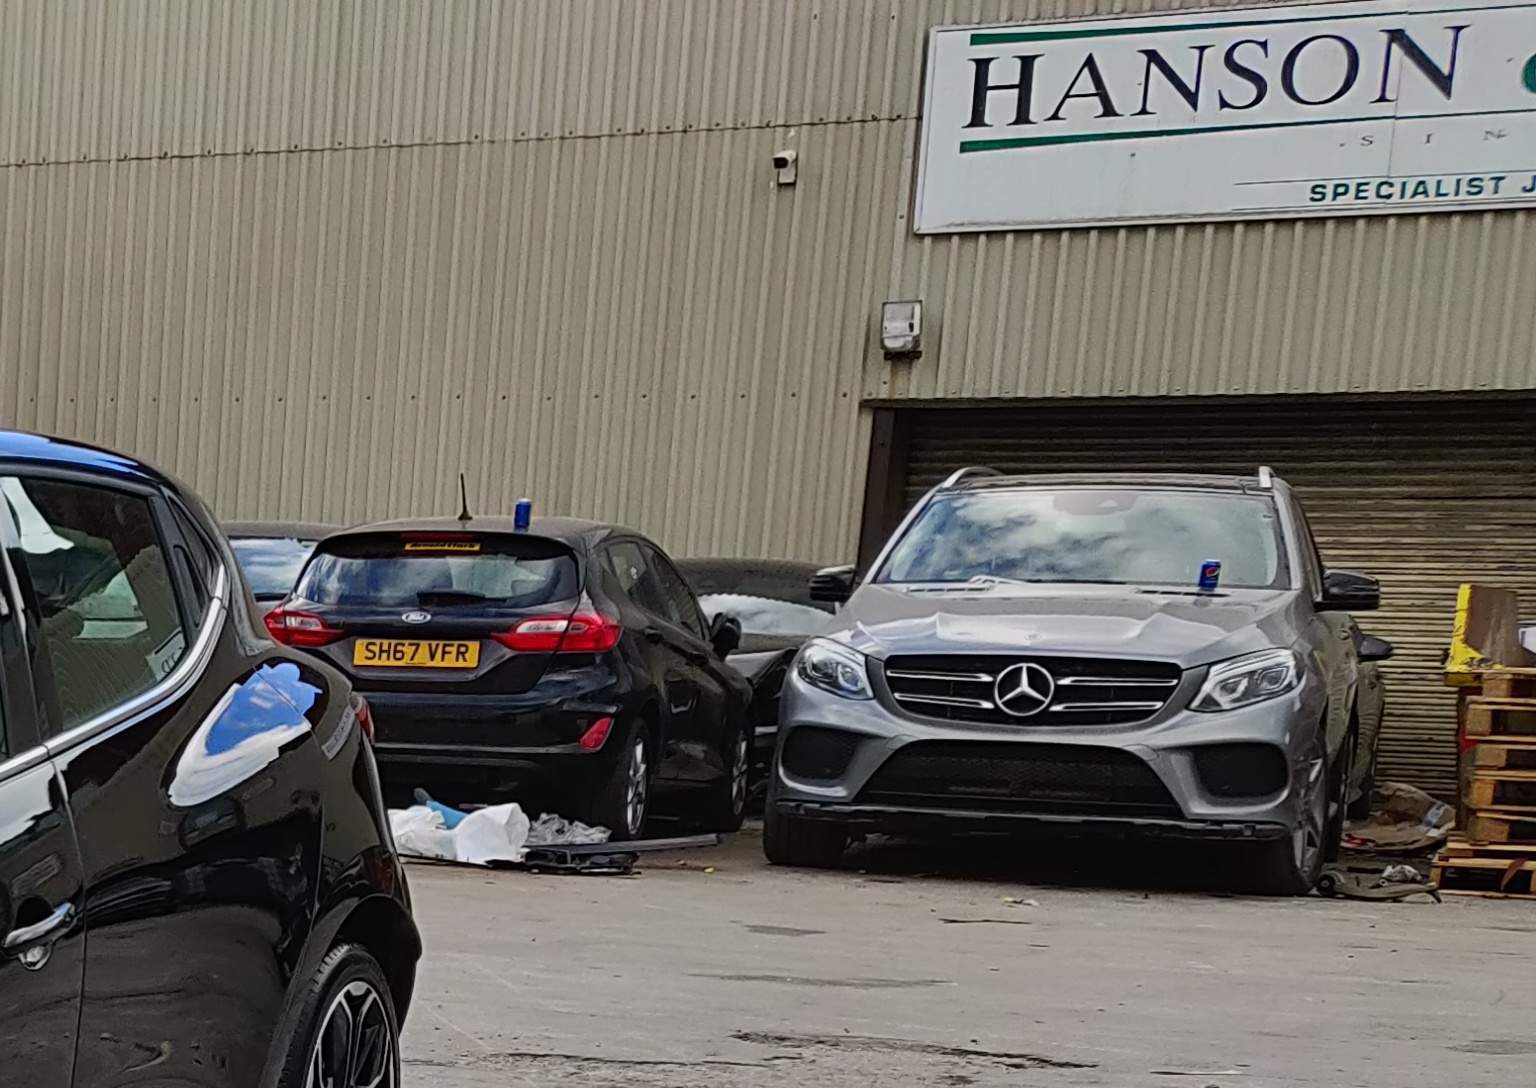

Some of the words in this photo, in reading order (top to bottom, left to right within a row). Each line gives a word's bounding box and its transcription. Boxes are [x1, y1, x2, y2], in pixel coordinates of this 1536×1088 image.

[961, 24, 1472, 128] HANSON
[1309, 176, 1507, 202] SPECIALIST
[364, 642, 421, 662] SH67
[428, 643, 469, 663] VFR
